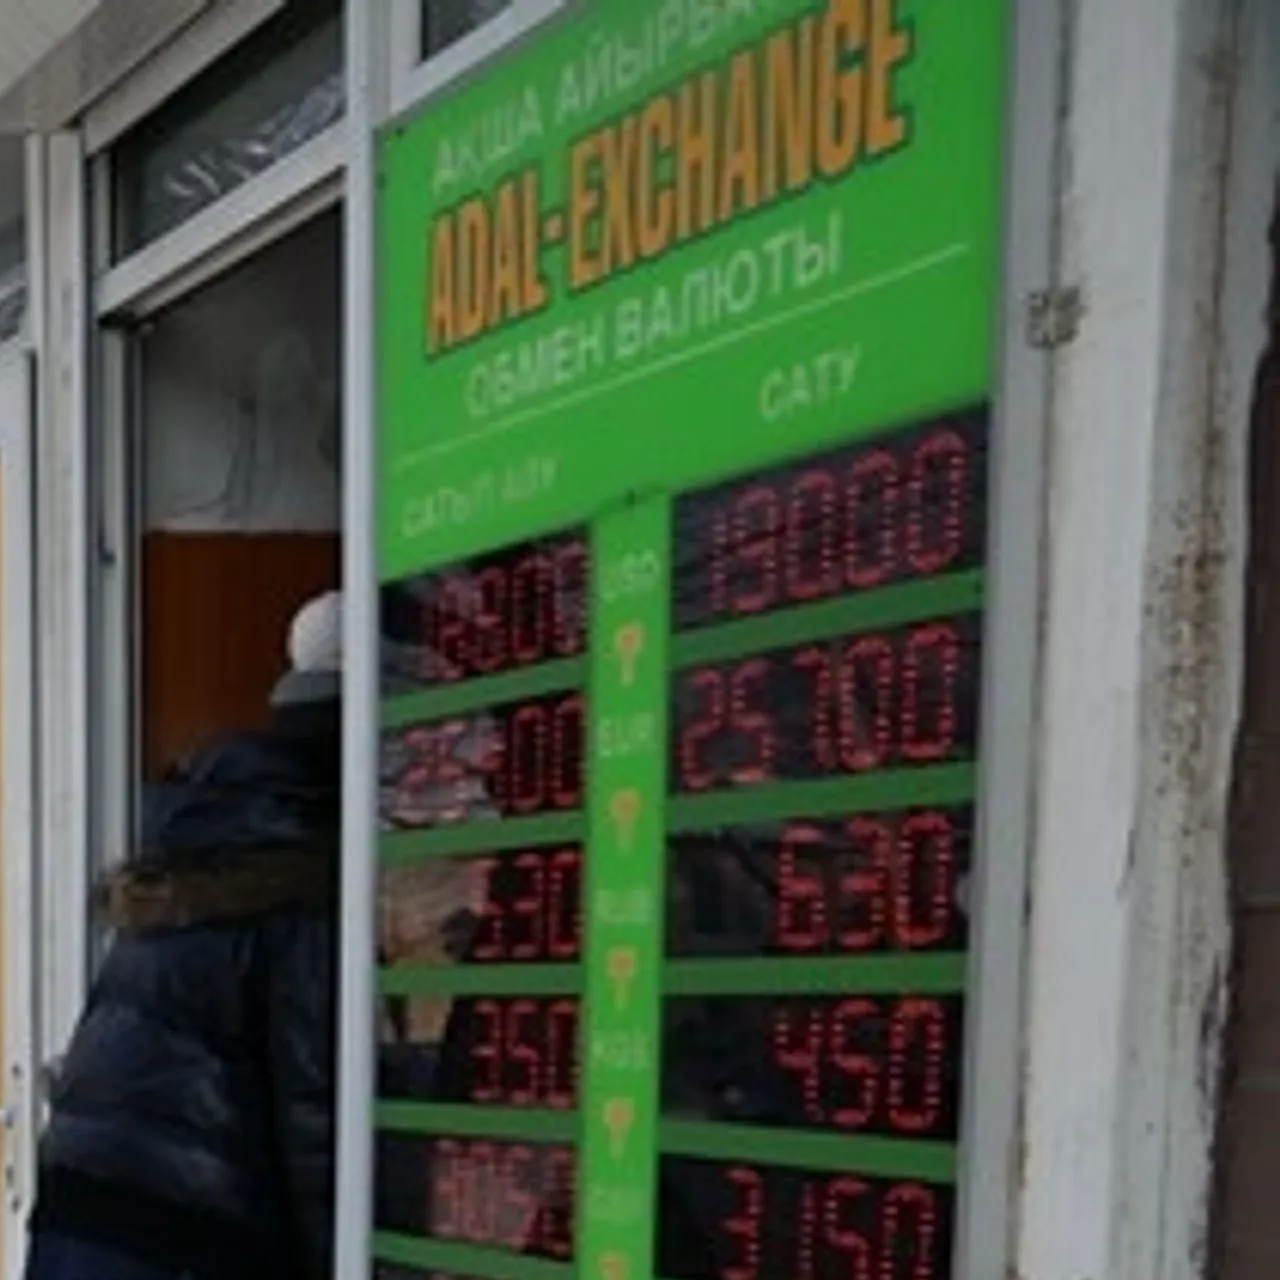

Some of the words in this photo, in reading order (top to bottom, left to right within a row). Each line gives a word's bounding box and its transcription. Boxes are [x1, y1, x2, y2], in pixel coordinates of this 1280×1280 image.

[425, 0, 912, 362] ADAL-EXCHANGE
[465, 308, 604, 417] ОБМЕН
[614, 208, 843, 358] ВАЛЮТЫ
[759, 344, 862, 420] САТУ
[778, 812, 952, 950] 630
[775, 998, 946, 1130] 450
